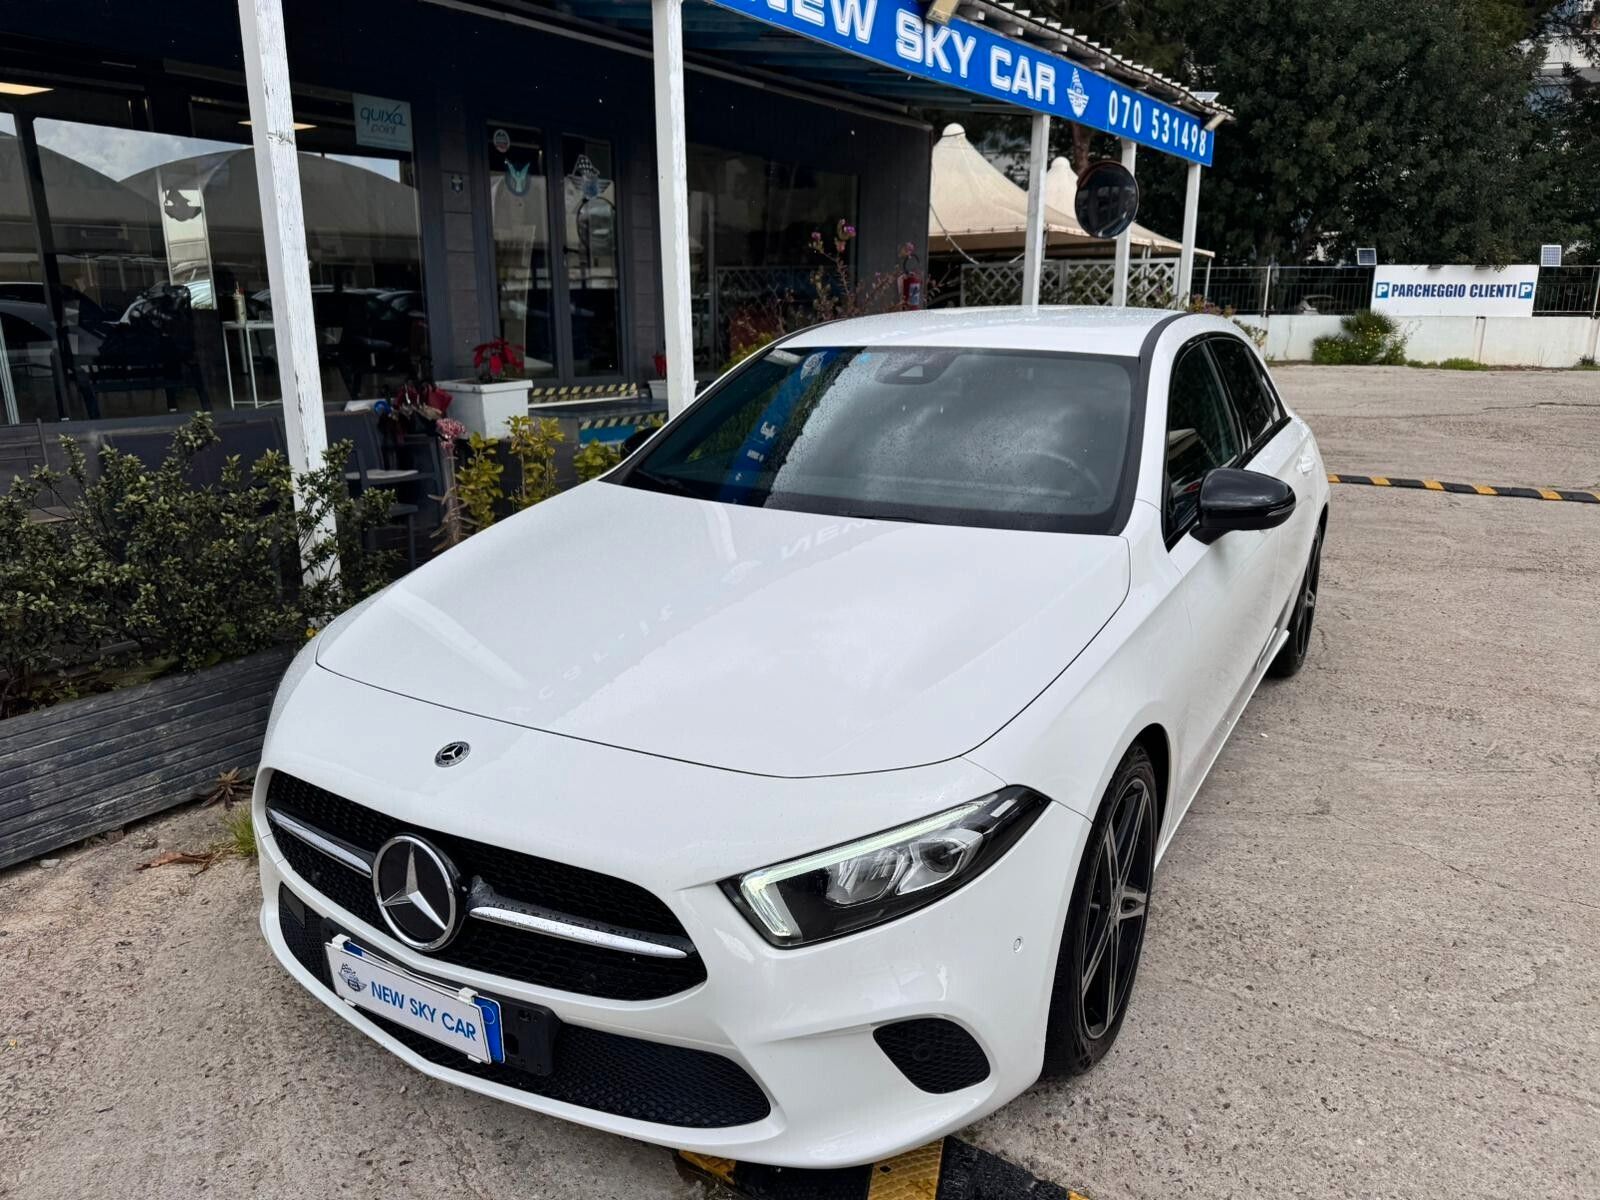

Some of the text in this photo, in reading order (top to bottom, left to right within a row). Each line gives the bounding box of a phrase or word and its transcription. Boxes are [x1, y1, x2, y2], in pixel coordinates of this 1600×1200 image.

[896, 8, 976, 78] SKY
[990, 45, 1055, 105] CAR
[1108, 90, 1207, 157] 070 531498
[1391, 284, 1466, 298] PARCHEGGIO
[1469, 284, 1517, 298] CLIENTI
[371, 981, 476, 1041] NEW SKY CAR
